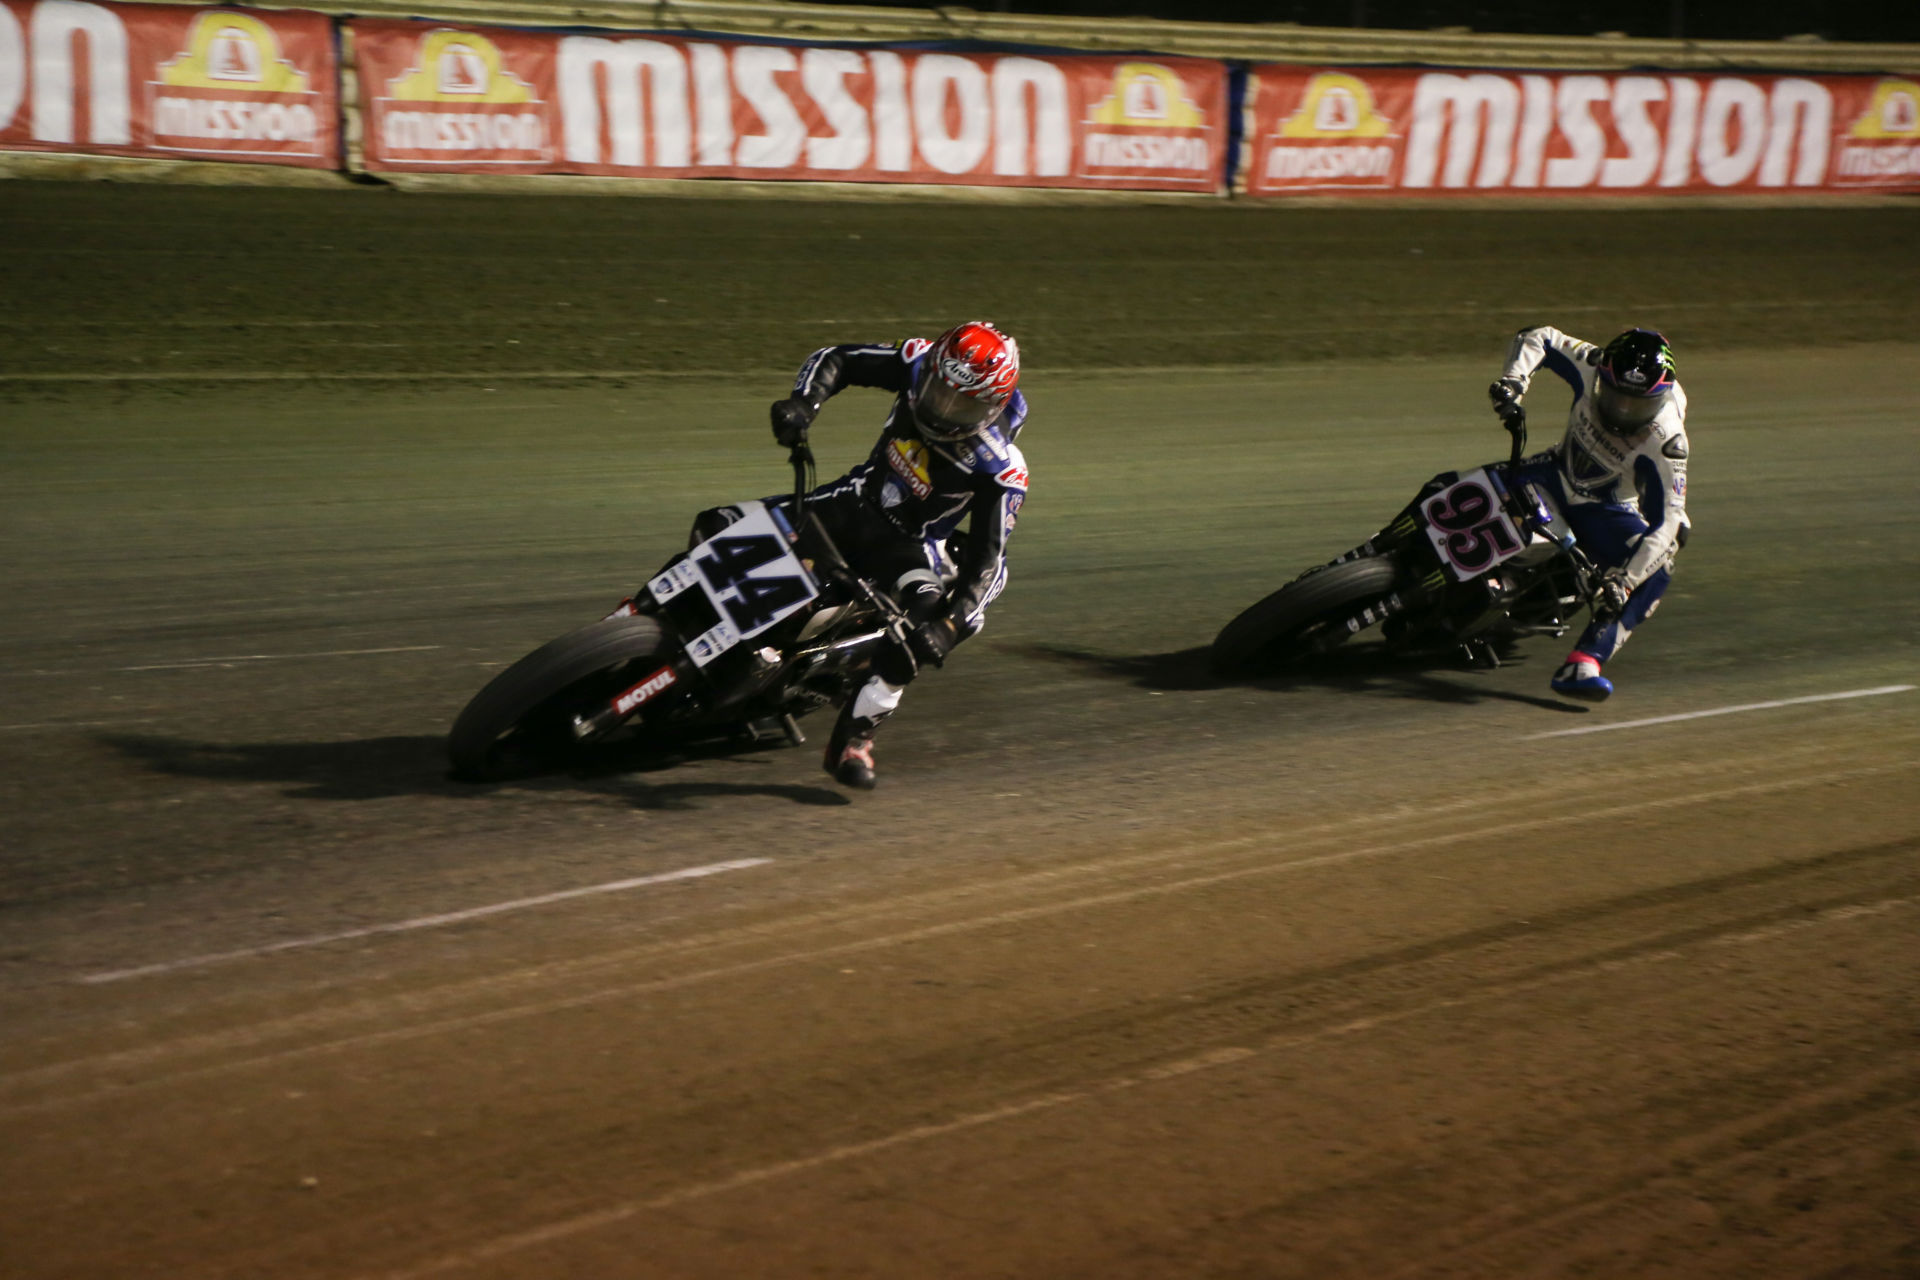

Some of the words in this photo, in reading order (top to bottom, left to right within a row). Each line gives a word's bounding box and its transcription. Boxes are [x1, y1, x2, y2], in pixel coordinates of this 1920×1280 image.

[153, 95, 316, 142] MISSION
[556, 36, 1072, 177] MISSION
[384, 111, 543, 150] MISSION
[1083, 133, 1209, 171] MISSION
[1402, 73, 1834, 189] MISSION
[1264, 145, 1394, 179] MISSION
[943, 357, 976, 385] Arai
[887, 444, 930, 498] MISSION
[1427, 480, 1521, 573] 95
[695, 533, 813, 635] 44
[616, 669, 677, 715] MOTUL
